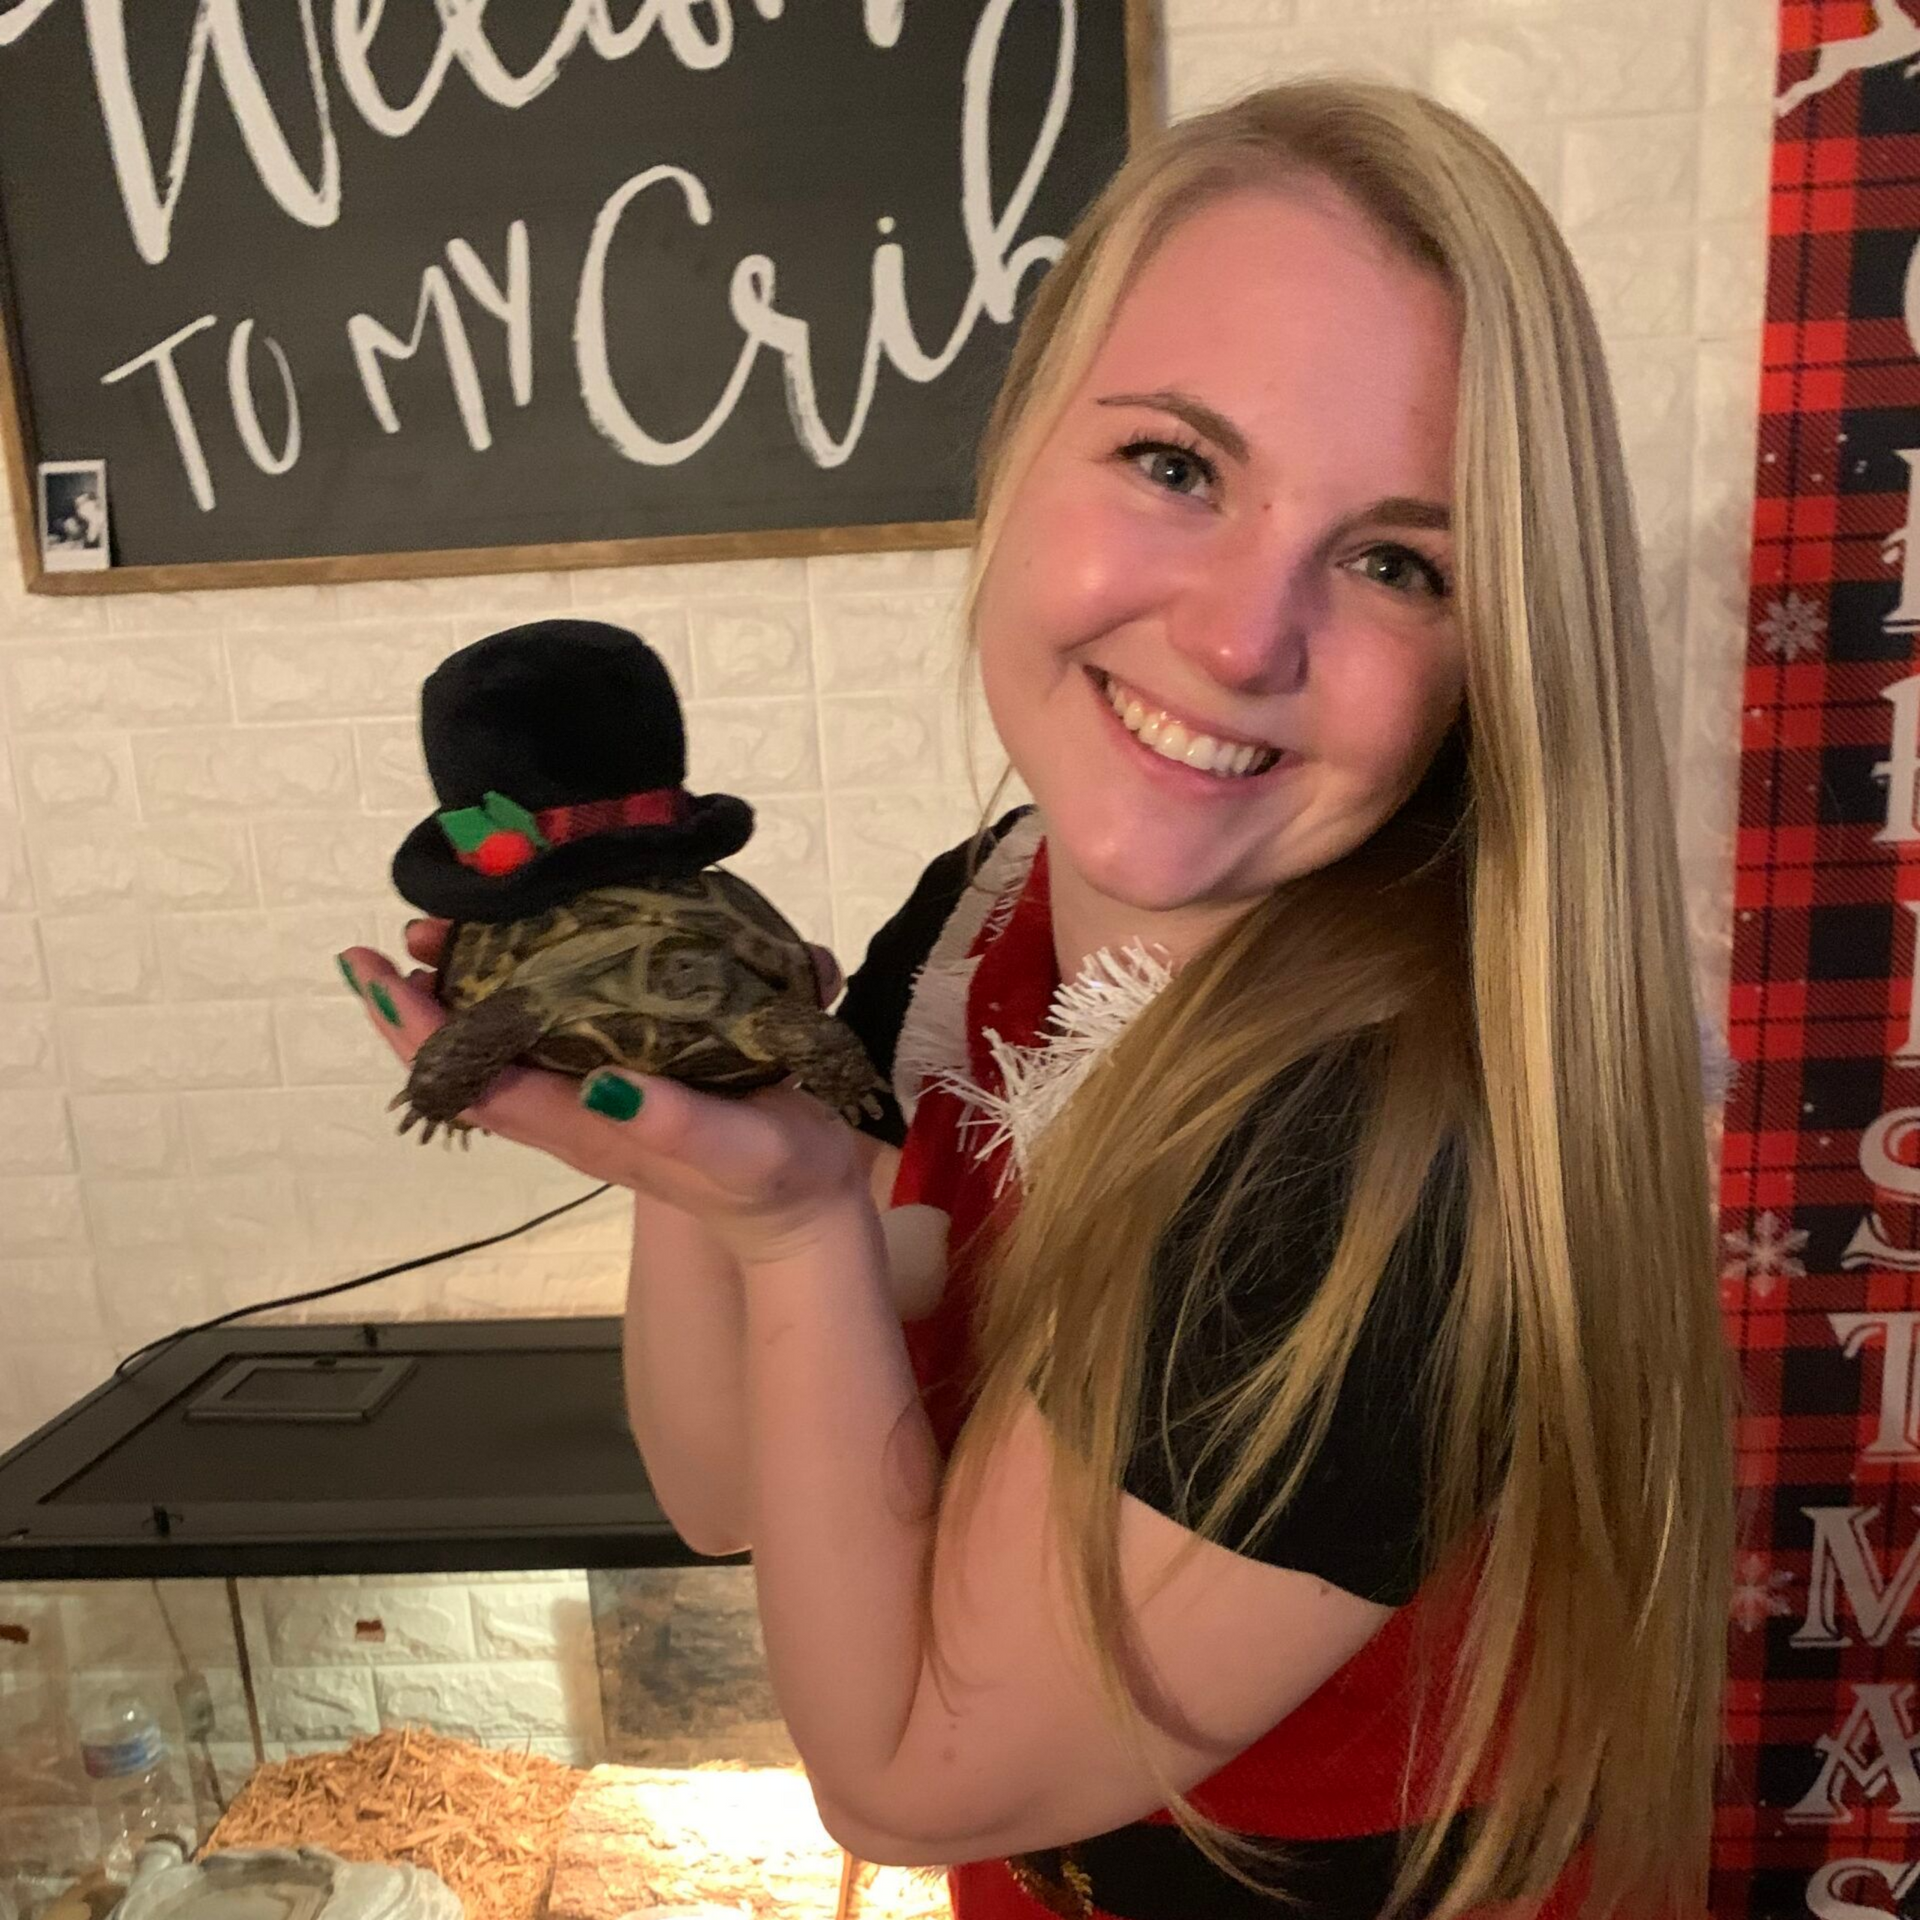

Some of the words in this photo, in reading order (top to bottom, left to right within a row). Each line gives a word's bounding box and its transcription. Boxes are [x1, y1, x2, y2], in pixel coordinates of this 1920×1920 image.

[101, 314, 302, 512] TO
[347, 219, 532, 452] MY
[574, 0, 1079, 467] Crib
